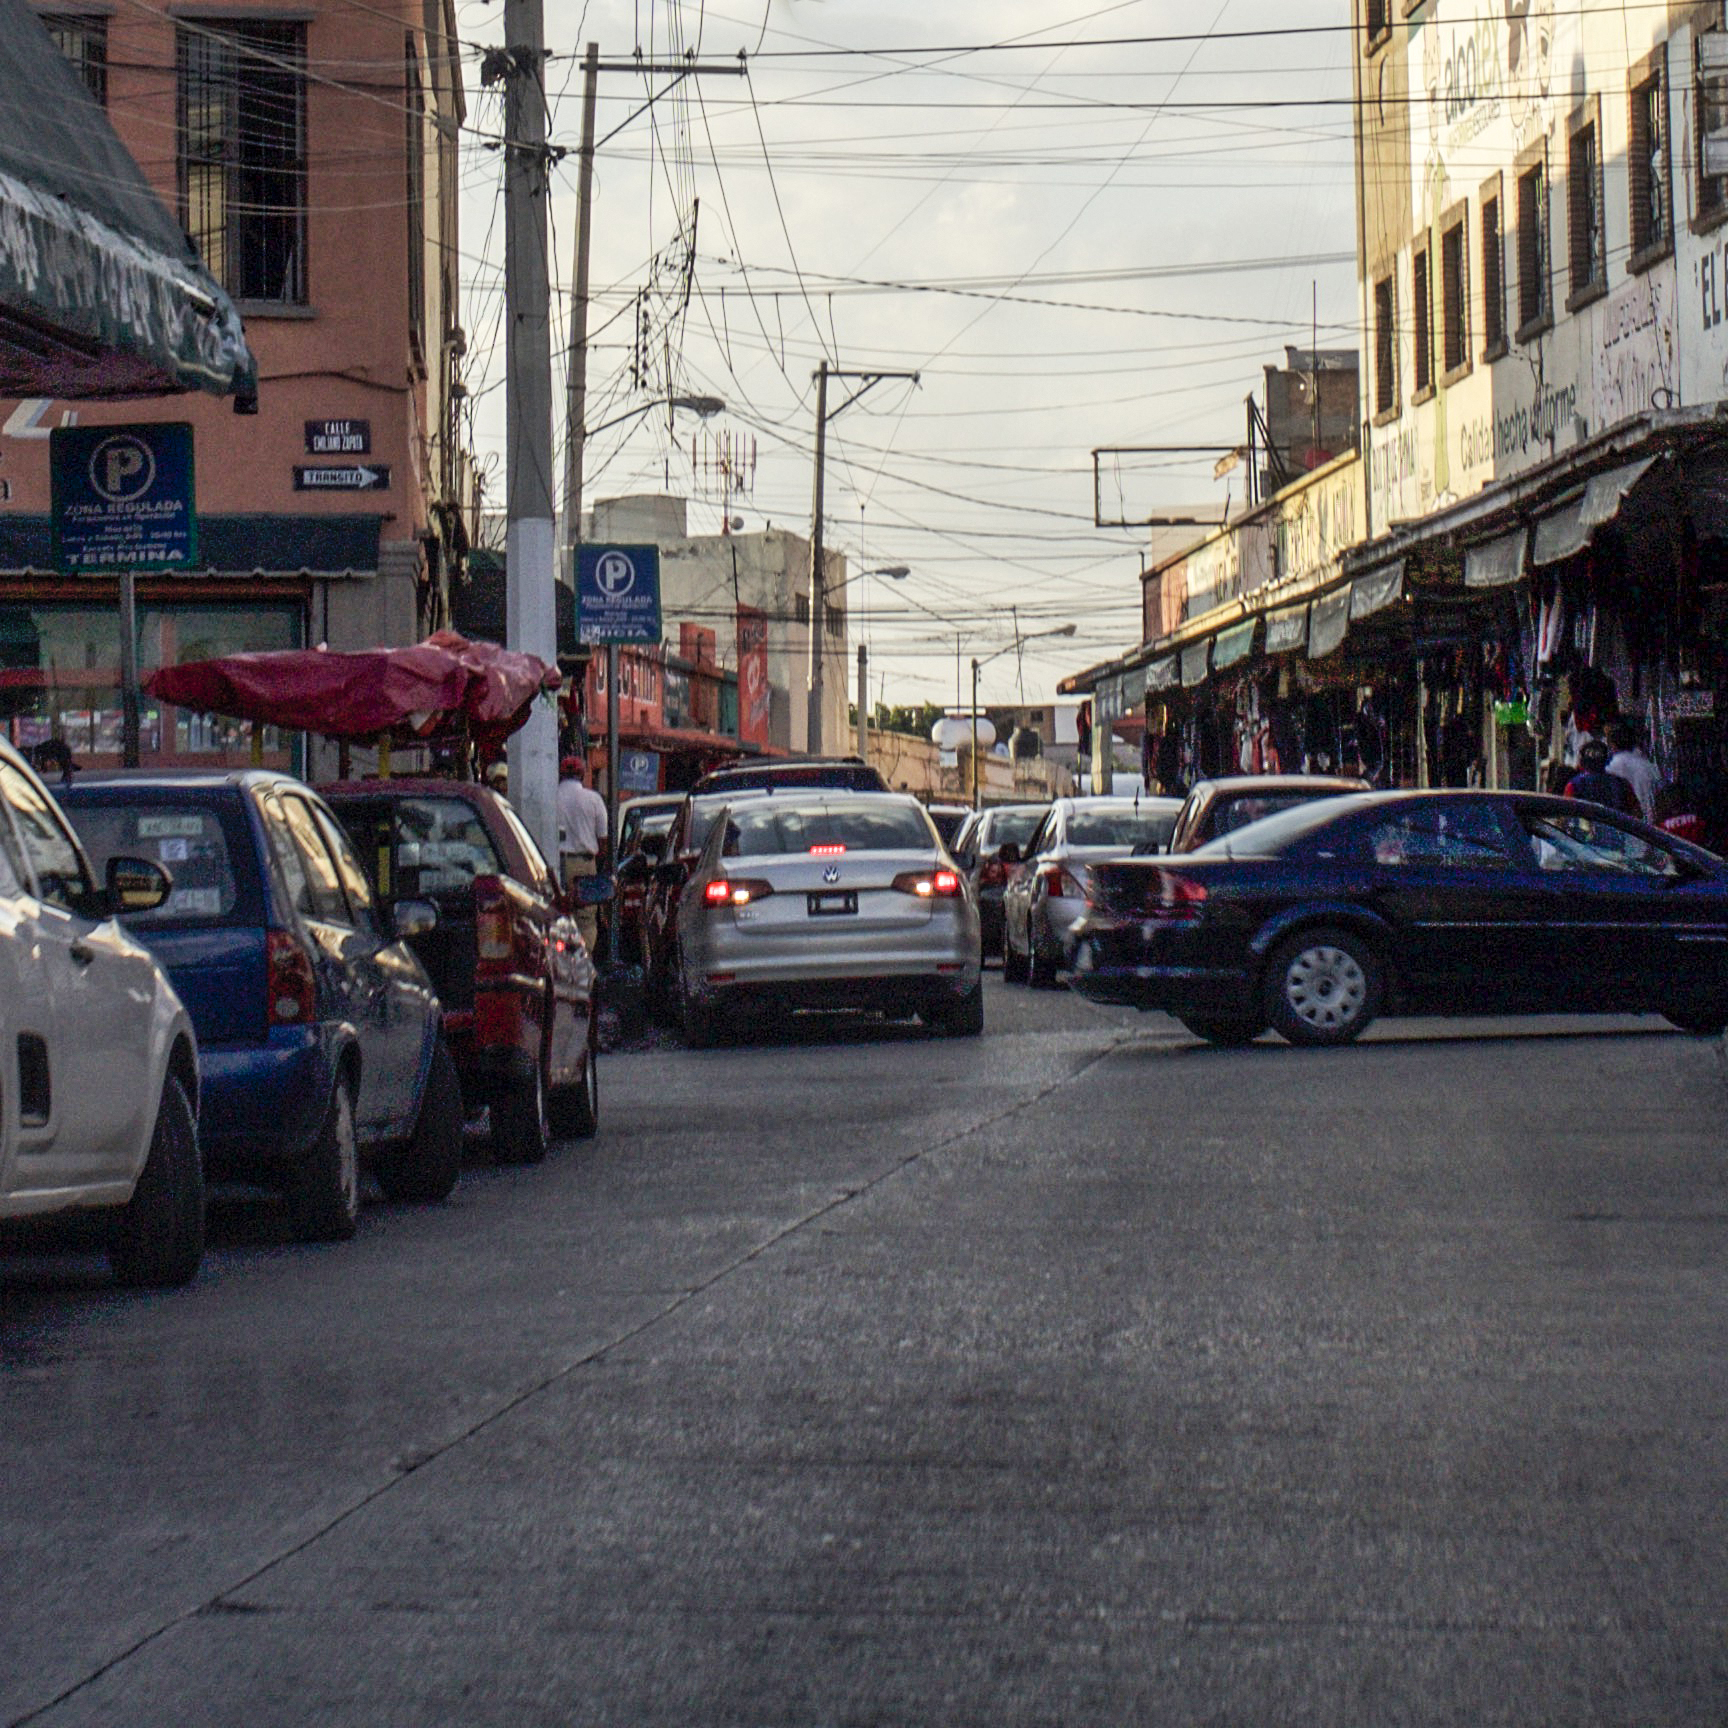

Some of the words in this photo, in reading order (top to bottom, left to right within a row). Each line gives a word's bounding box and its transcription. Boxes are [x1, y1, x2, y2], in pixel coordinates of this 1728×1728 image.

[1701, 251, 1721, 332] EL
[325, 421, 350, 435] CALLE
[1461, 414, 1495, 472] Calidad
[307, 471, 363, 485] TRANSITO
[65, 503, 103, 515] ZONA
[107, 499, 183, 513] REGULADA
[66, 548, 185, 565] TERMINA
